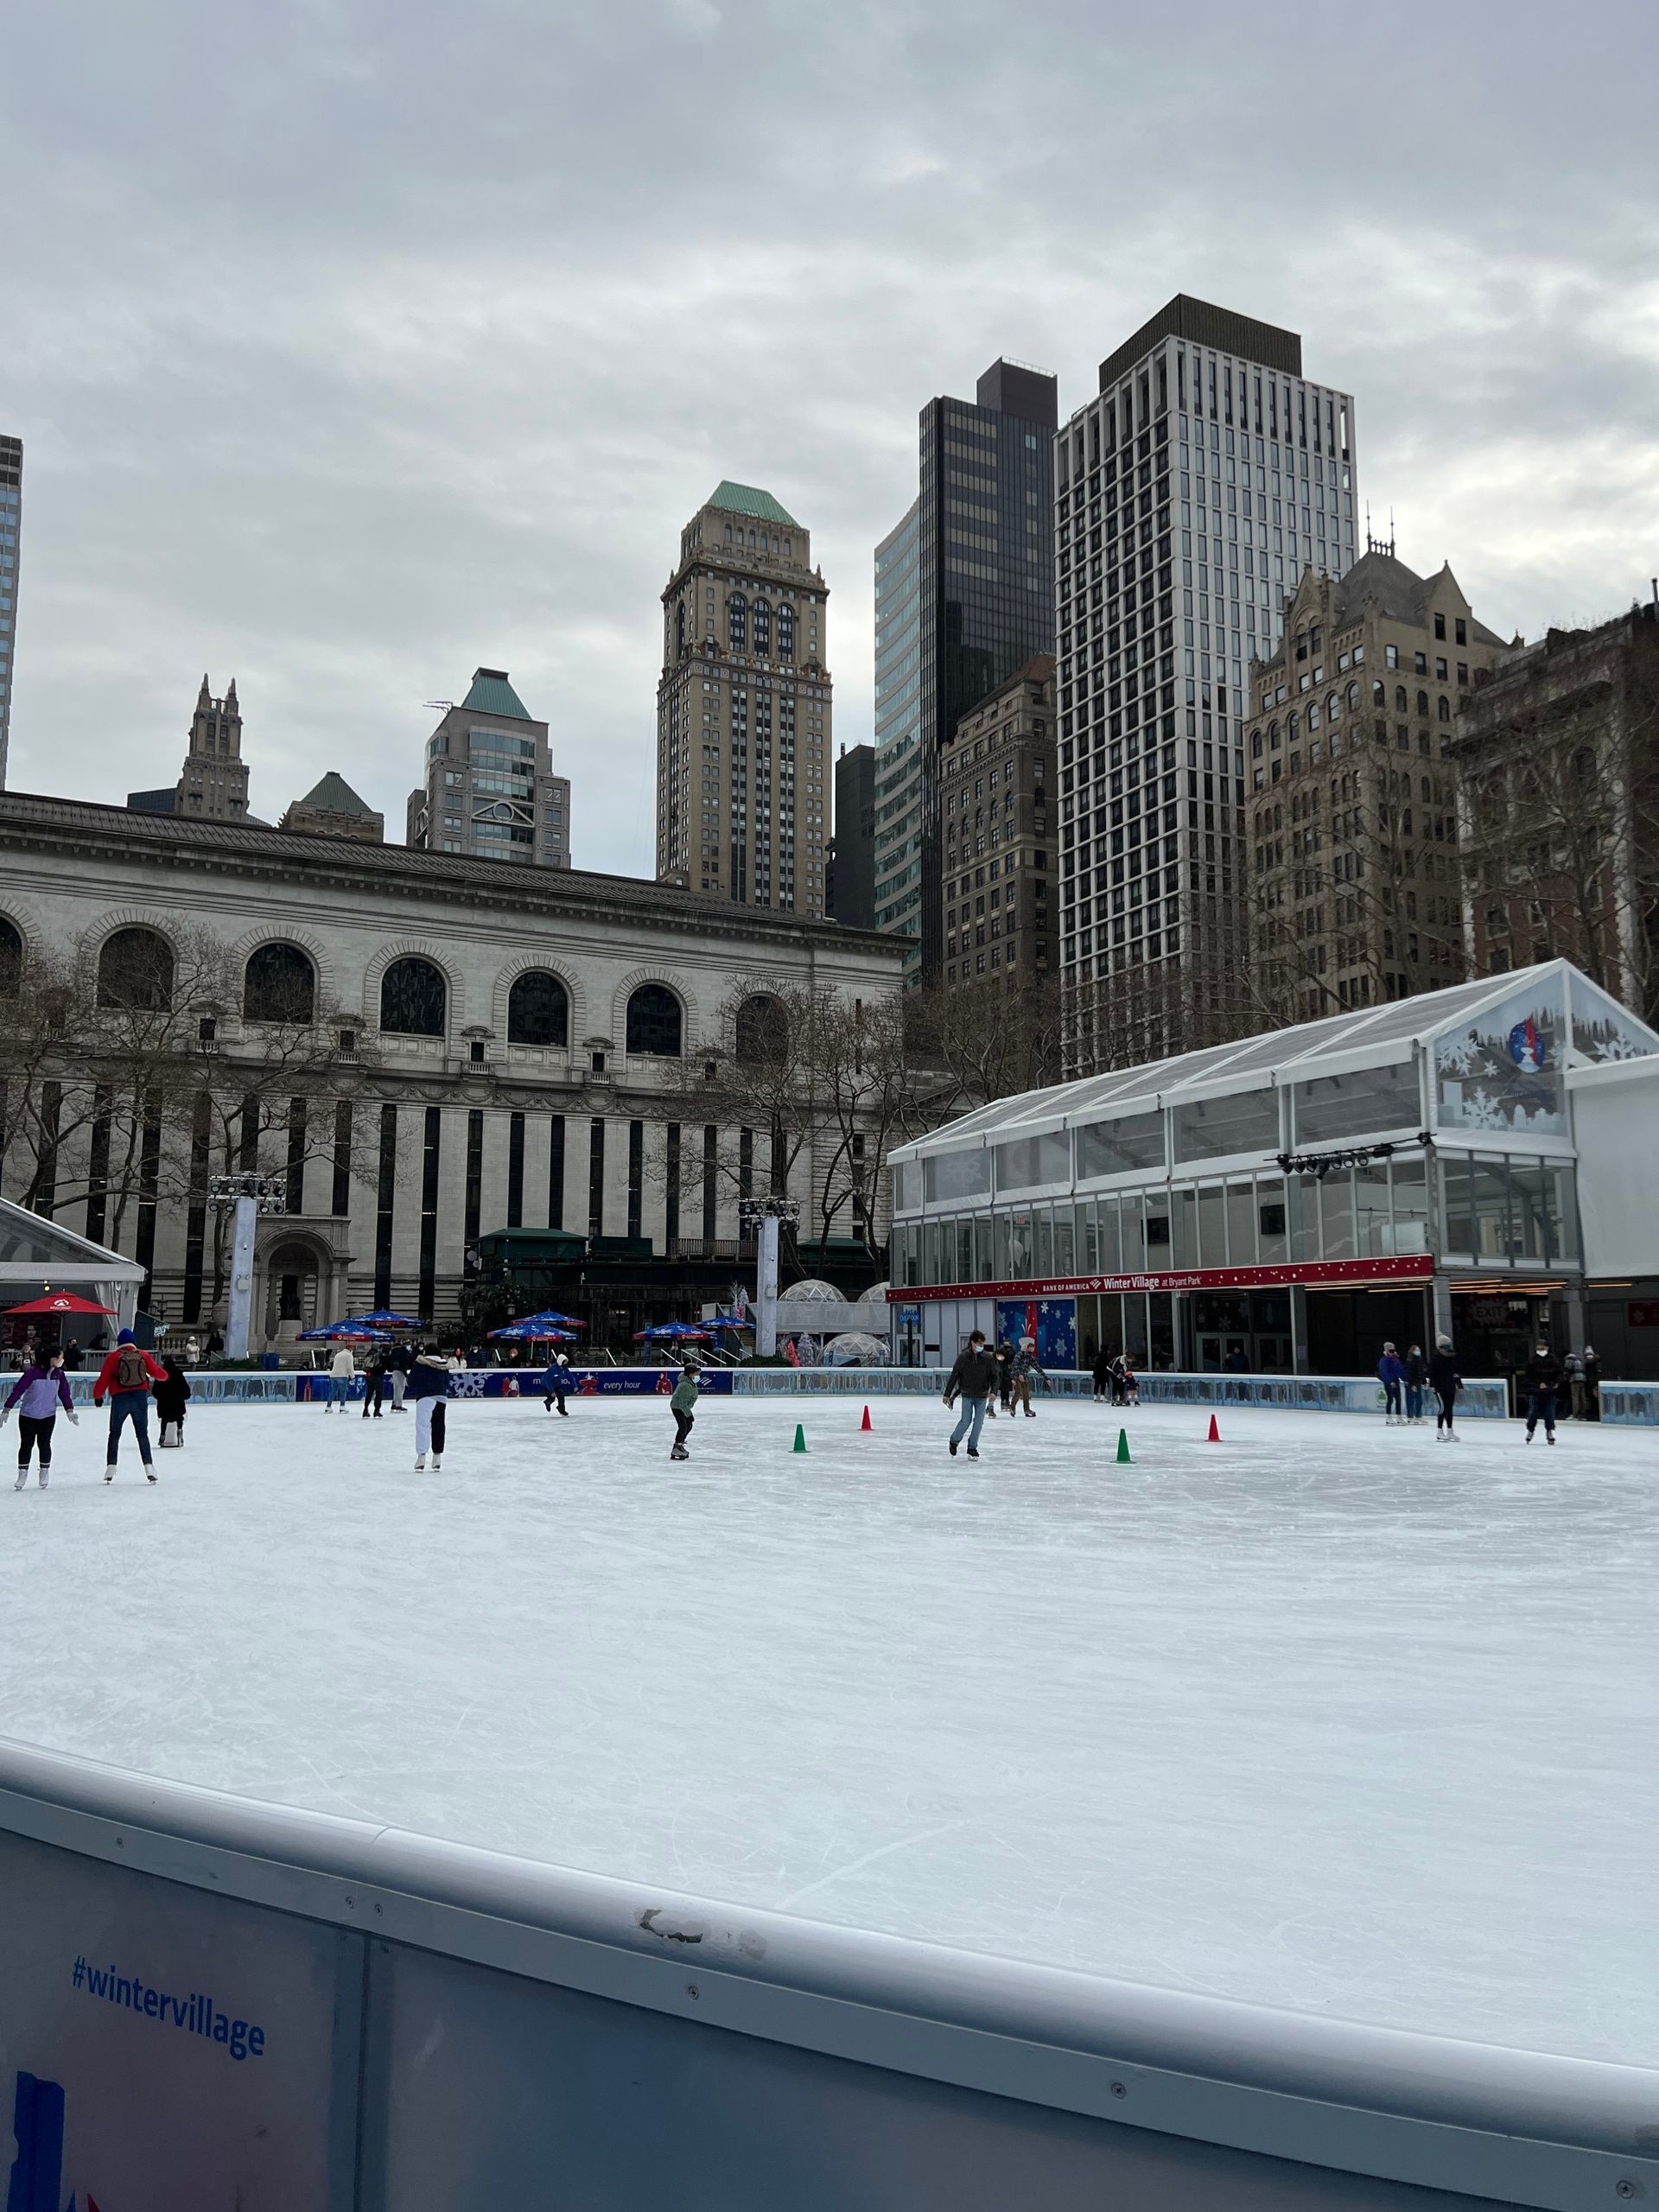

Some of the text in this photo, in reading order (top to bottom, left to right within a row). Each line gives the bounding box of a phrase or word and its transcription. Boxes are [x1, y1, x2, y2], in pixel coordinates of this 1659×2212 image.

[1103, 1278, 1130, 1289] Winter
[1131, 1275, 1160, 1290] Village
[1169, 1277, 1187, 1287] Bryant
[1188, 1276, 1201, 1286] Park
[1477, 1306, 1502, 1318] EXIT
[603, 1382, 623, 1391] every
[73, 1955, 264, 2061] #wintervillage
